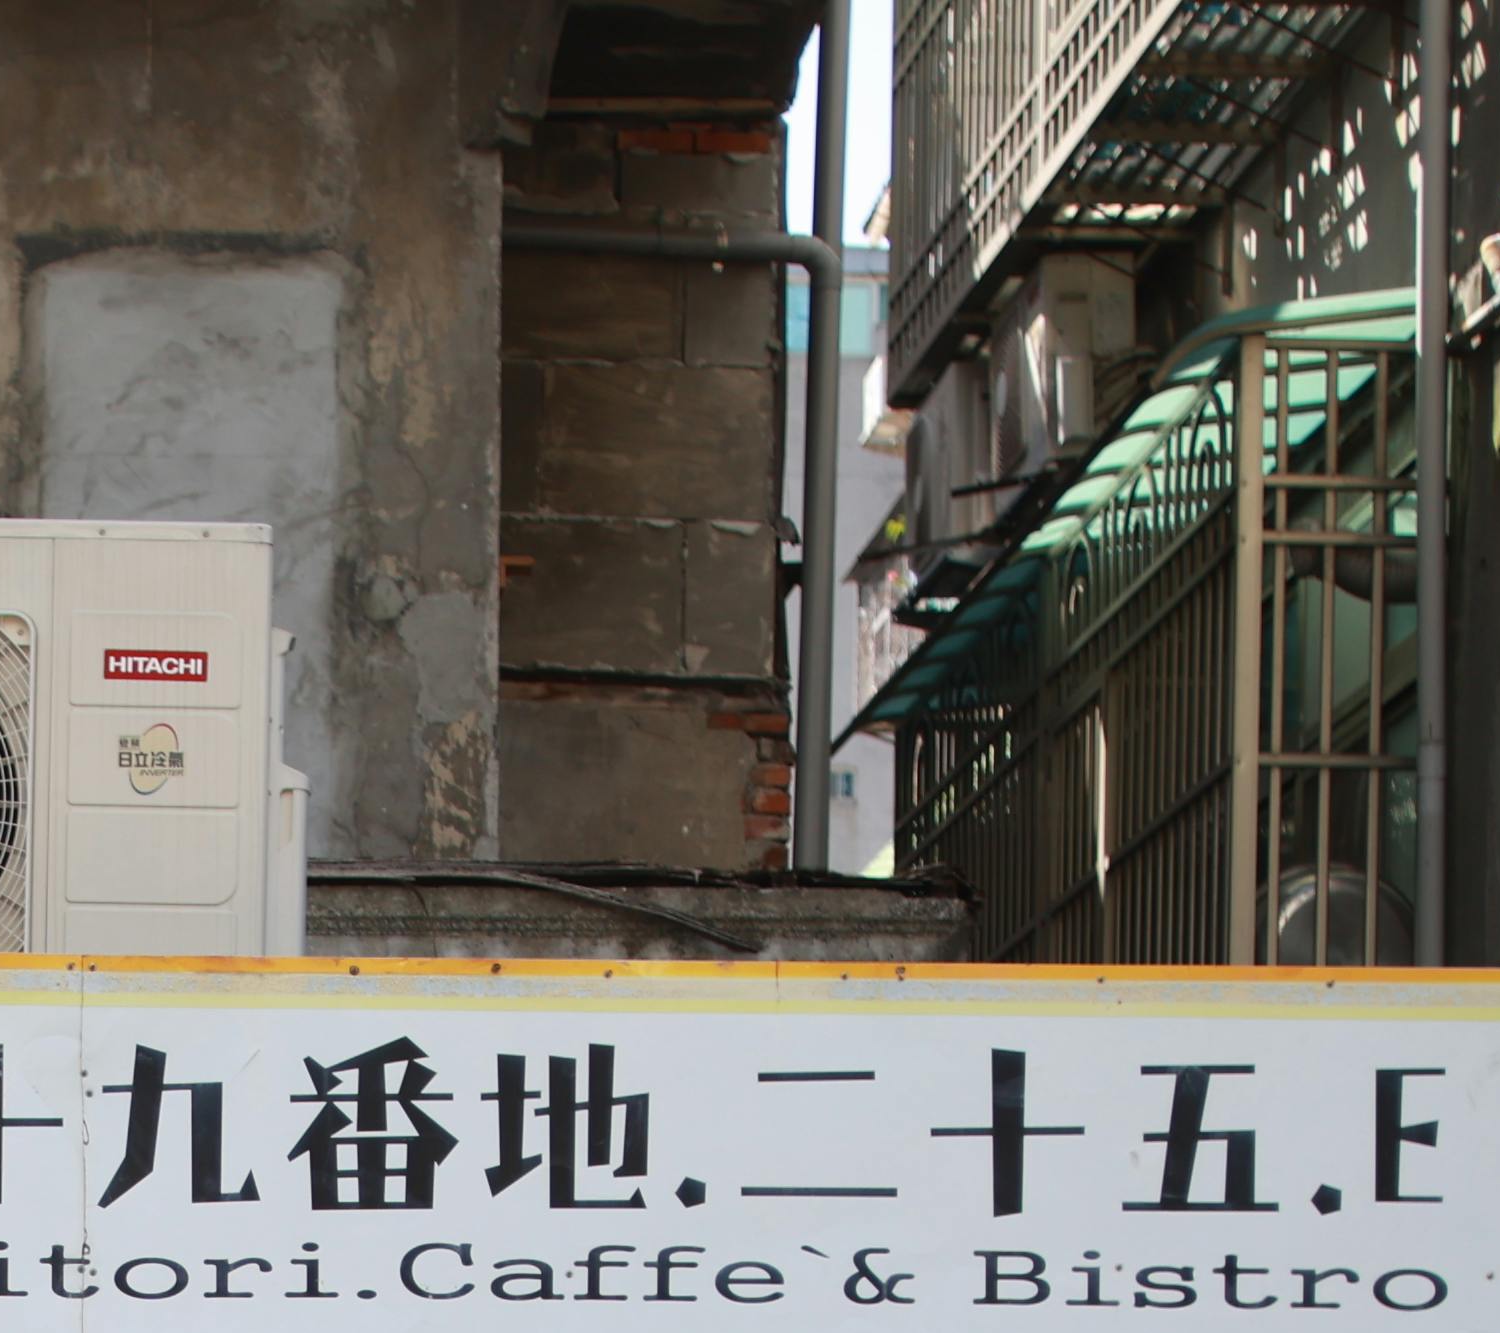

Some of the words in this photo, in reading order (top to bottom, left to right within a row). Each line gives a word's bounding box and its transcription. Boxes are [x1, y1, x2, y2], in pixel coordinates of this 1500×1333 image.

[109, 656, 203, 676] HITACHI
[118, 752, 184, 768] 日立冷氣
[973, 1248, 1450, 1313] Bistro
